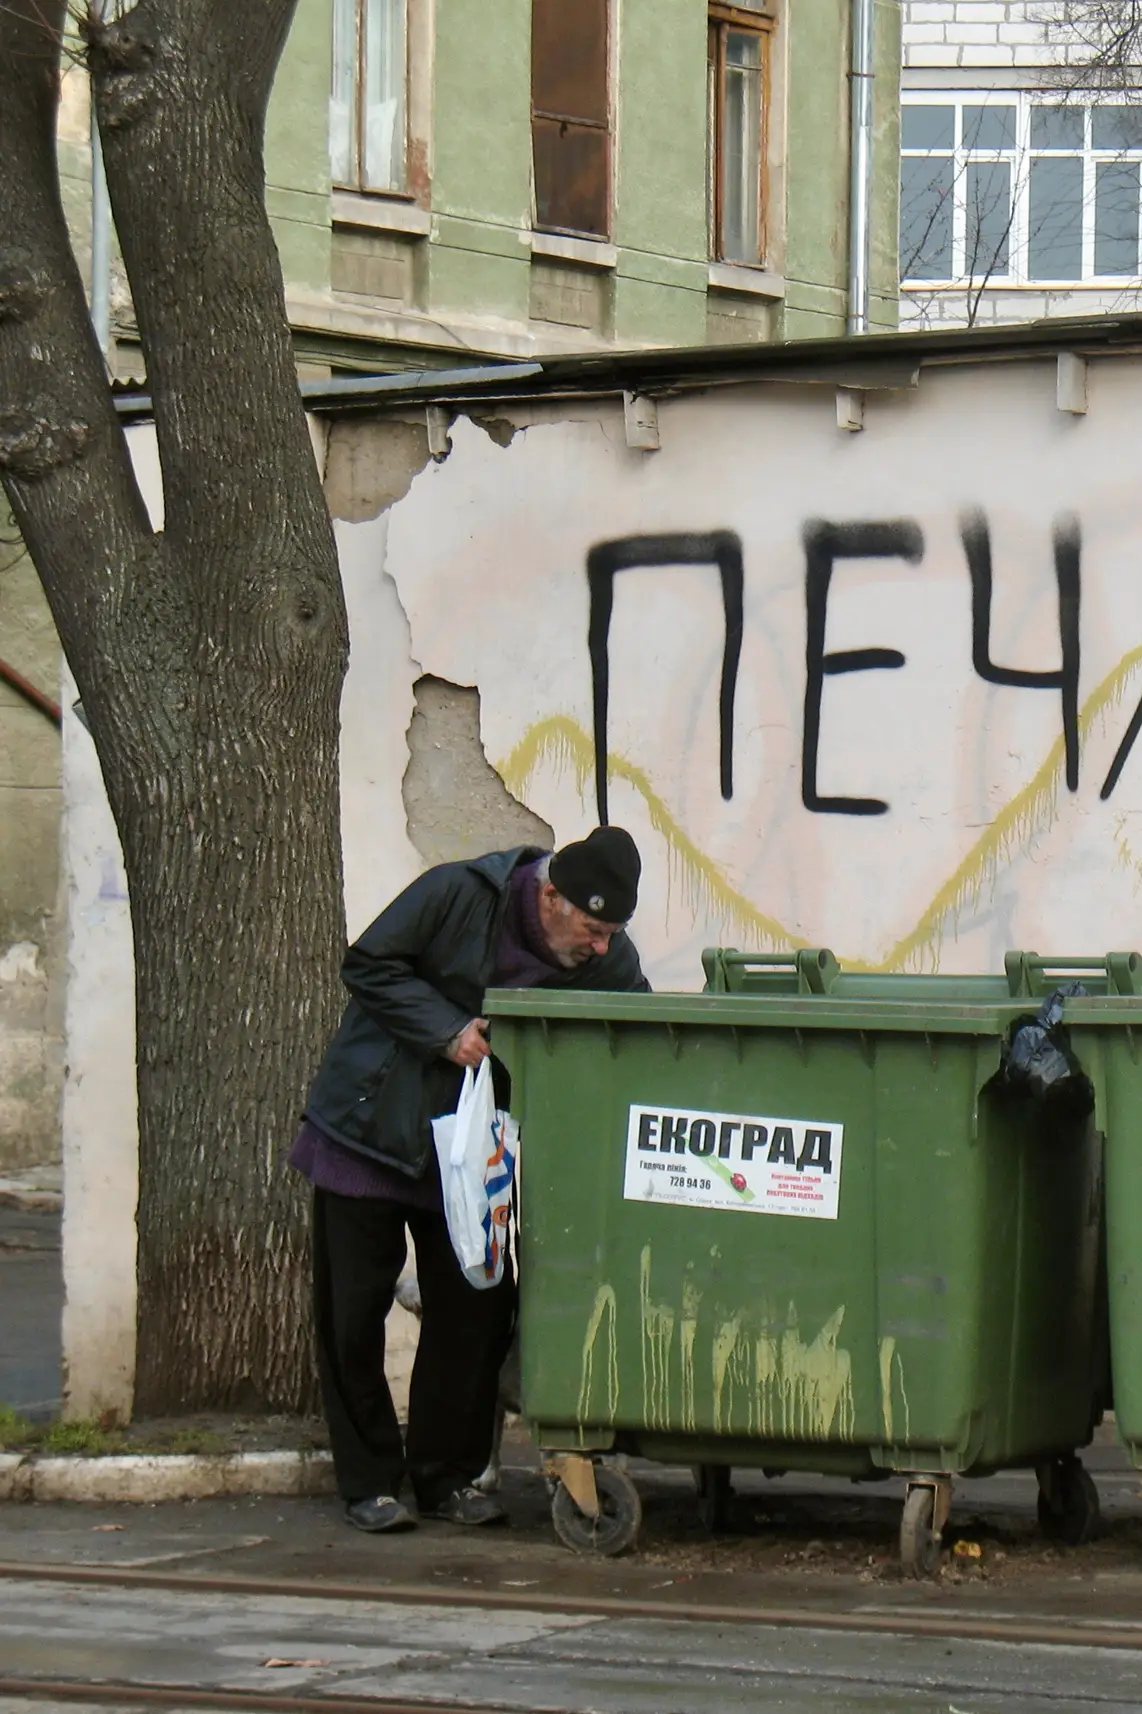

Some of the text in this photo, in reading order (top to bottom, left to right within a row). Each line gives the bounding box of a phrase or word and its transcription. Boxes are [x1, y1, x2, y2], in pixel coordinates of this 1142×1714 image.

[637, 1113, 833, 1174] ЕКОГРАД
[669, 1175, 711, 1190] 728 94 36
